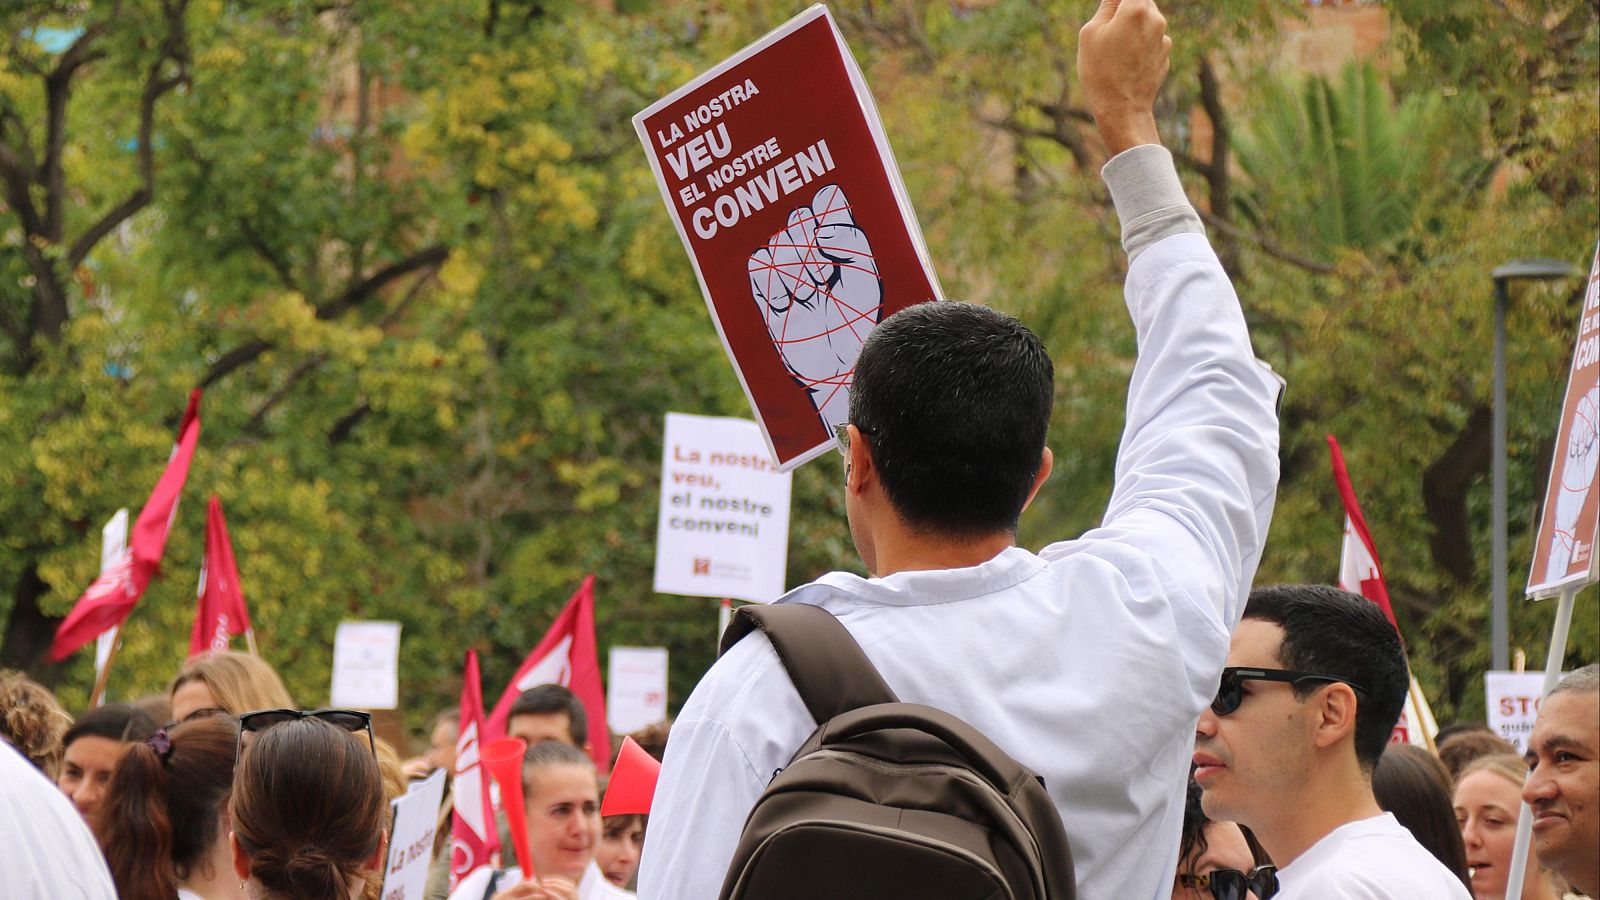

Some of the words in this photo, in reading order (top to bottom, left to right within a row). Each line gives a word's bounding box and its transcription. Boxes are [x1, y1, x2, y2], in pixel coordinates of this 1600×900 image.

[657, 122, 685, 148] LA
[683, 78, 760, 132] NOSTRA
[665, 122, 732, 181] VEU
[679, 182, 706, 207] EL
[705, 136, 782, 192] NOSTRE
[691, 138, 836, 240] CONVENI
[673, 444, 701, 464] La
[672, 470, 721, 491] veu,
[671, 492, 691, 506] el
[700, 495, 773, 518] nostre
[668, 516, 760, 538] conveni
